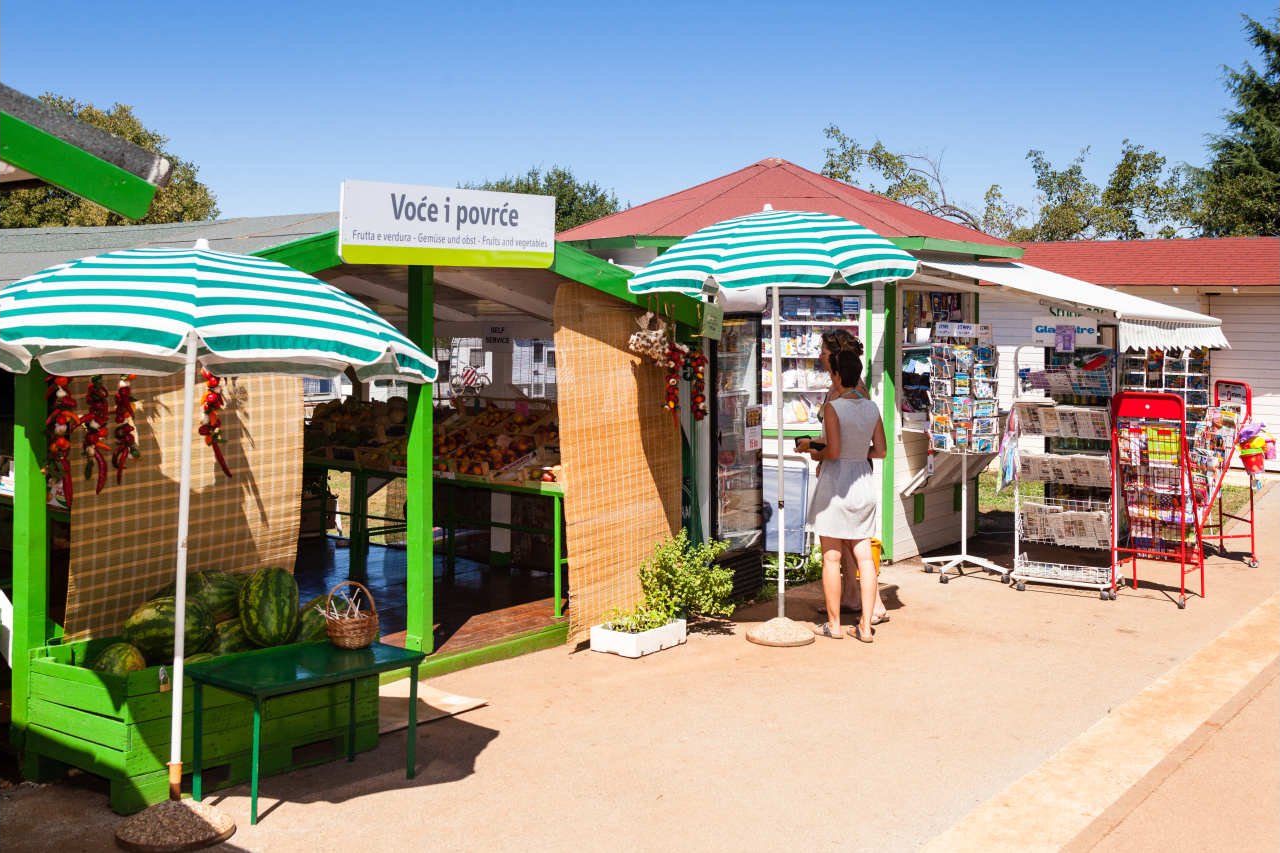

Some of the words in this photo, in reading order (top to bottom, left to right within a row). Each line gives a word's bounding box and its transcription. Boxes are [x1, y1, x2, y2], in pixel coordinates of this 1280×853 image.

[390, 193, 438, 222] Voće
[444, 196, 451, 223] i
[456, 202, 518, 230] povrće
[352, 229, 376, 241] Frutta
[376, 232, 382, 241] e
[383, 231, 412, 242] verdura
[447, 235, 461, 245] und
[482, 235, 500, 246] Fruits
[501, 237, 514, 247] and
[515, 238, 548, 249] vegetables
